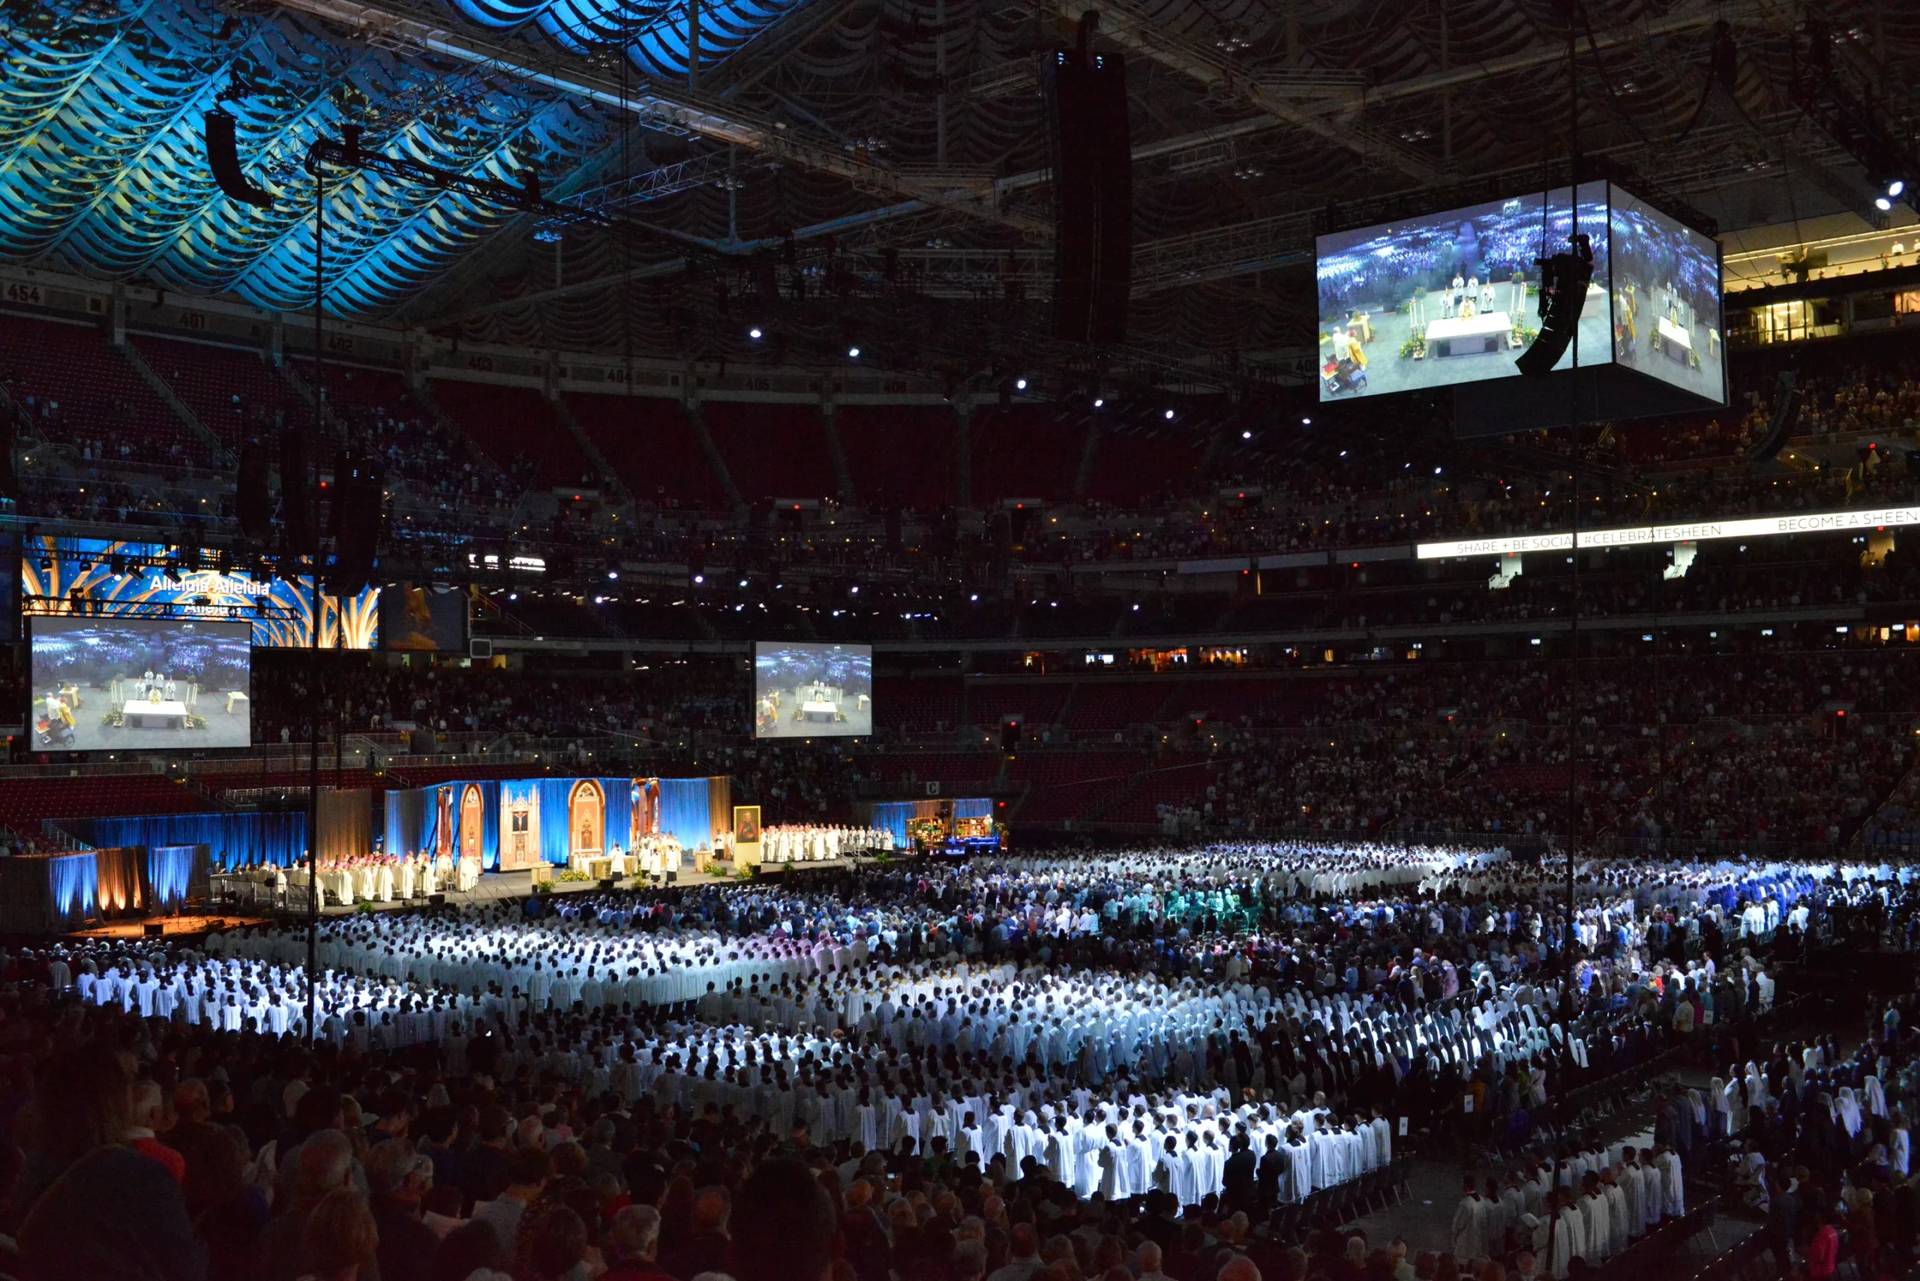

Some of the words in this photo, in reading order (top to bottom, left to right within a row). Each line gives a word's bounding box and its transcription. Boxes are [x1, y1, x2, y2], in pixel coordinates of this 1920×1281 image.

[7, 283, 41, 303] 454
[178, 311, 205, 329] 401
[328, 335, 353, 353] 402
[467, 355, 493, 372] 403
[1778, 515, 1844, 531] BECOME
[1849, 514, 1859, 525] A
[1863, 510, 1918, 525] SHEEN
[1457, 541, 1498, 554] SHARE
[1513, 539, 1529, 552] BE
[1584, 525, 1721, 544] #CELEBRATESHEEN
[215, 578, 271, 595] Alleluia
[929, 783, 937, 793] C
